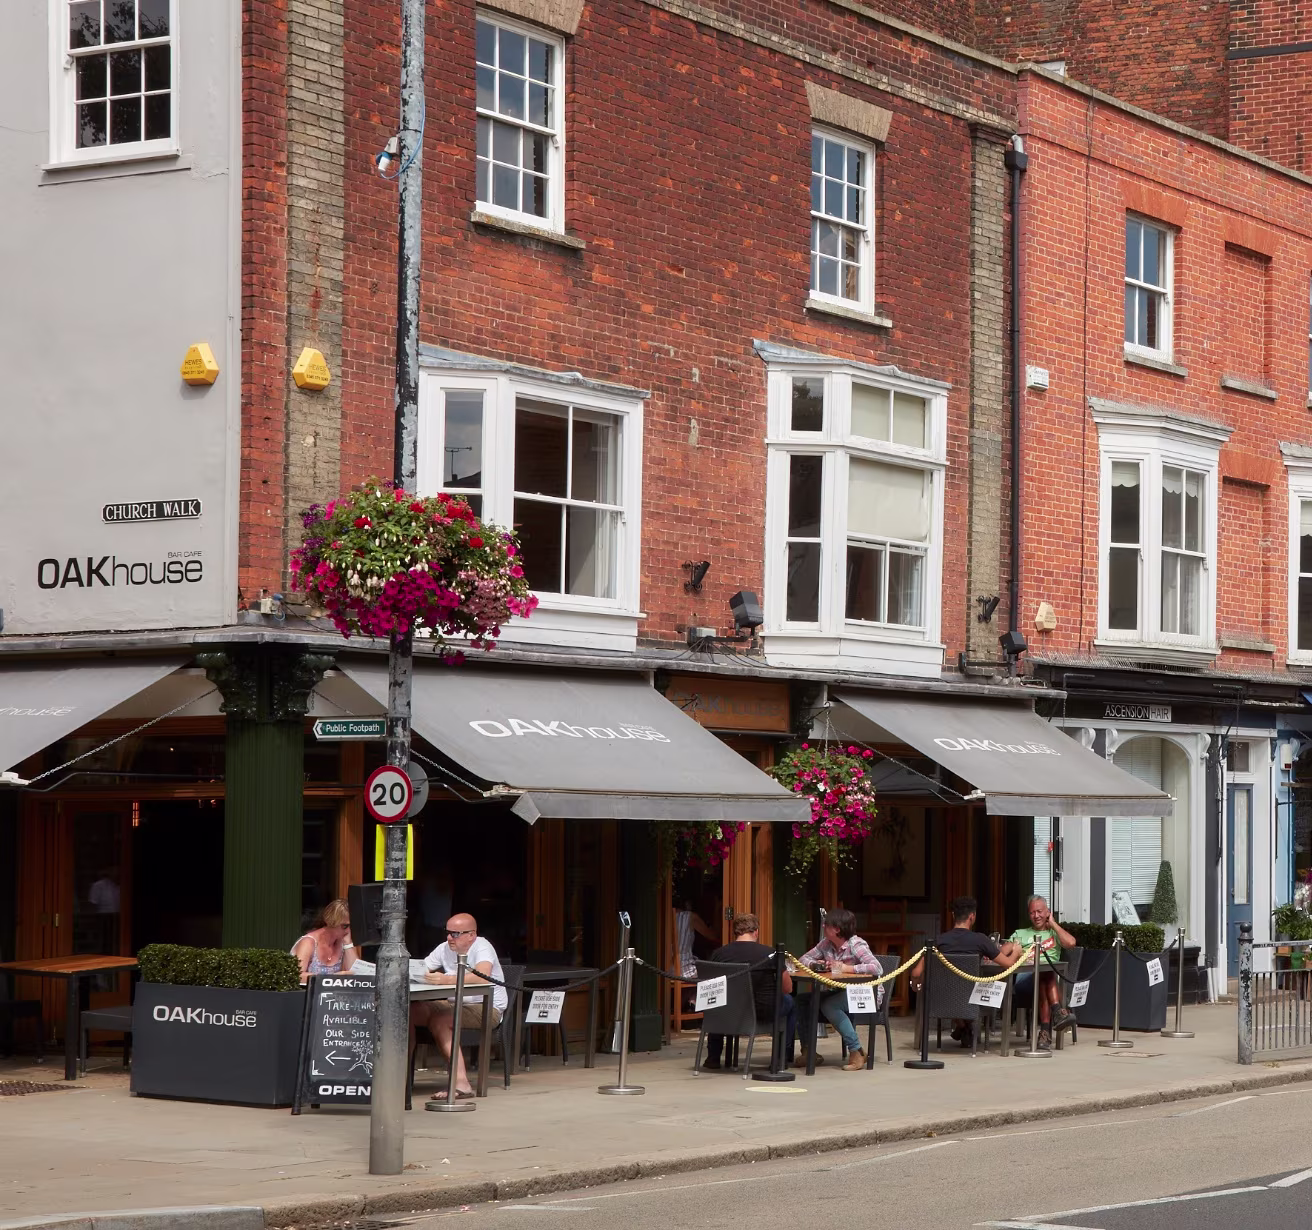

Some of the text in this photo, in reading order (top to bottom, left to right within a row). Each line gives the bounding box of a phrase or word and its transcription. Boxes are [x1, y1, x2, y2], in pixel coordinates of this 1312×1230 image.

[184, 358, 203, 366] HEWES
[105, 501, 198, 520] CHURCH WALK
[38, 556, 203, 589] OAKhouse
[1105, 705, 1169, 720] ASCENSION HAIR
[326, 724, 379, 732] Public Footpath
[468, 718, 671, 742] OAKhouse
[933, 738, 1062, 756] OAKhouse
[372, 782, 405, 806] 20
[153, 1005, 257, 1028] OAKhouse
[323, 1014, 367, 1026] AVAILIBLE
[326, 1030, 370, 1038] OUR SIDE
[319, 1085, 371, 1096] OPEN
